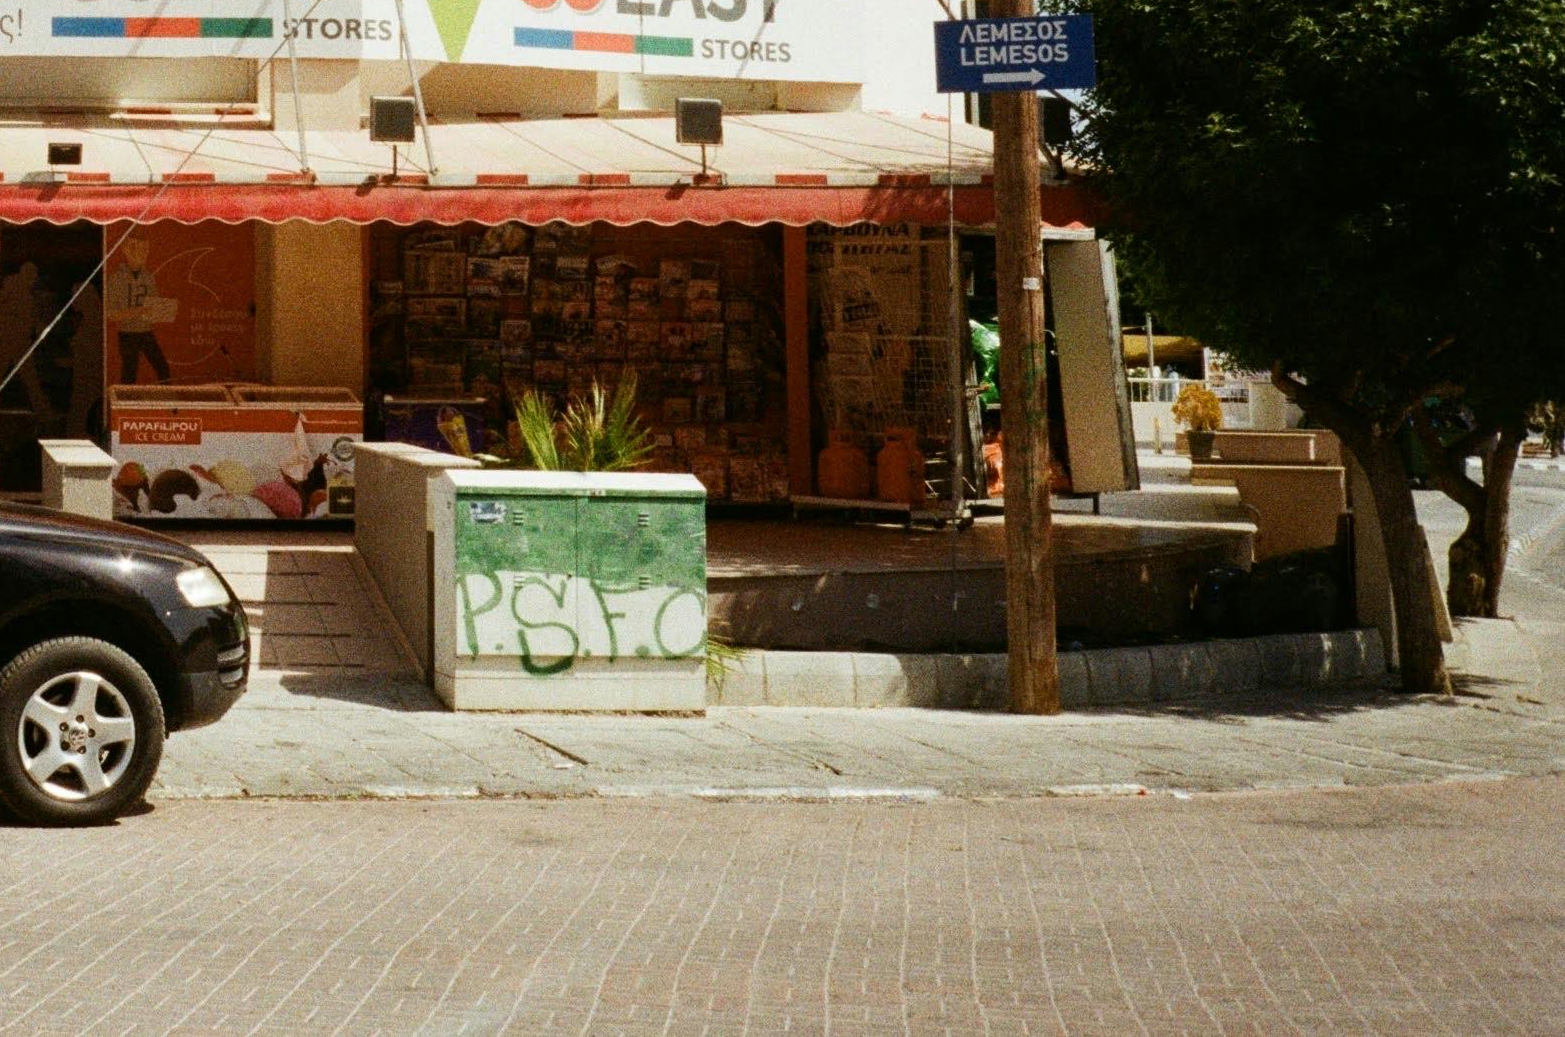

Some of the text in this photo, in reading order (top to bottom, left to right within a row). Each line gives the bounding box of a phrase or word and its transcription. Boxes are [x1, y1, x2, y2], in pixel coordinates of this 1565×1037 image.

[281, 17, 393, 41] STORES
[959, 20, 1068, 45] ΛΕΜΕΣΟΣ
[700, 38, 793, 62] STORES
[960, 43, 1069, 66] LEMESOS
[136, 432, 186, 443] ICE CREAM
